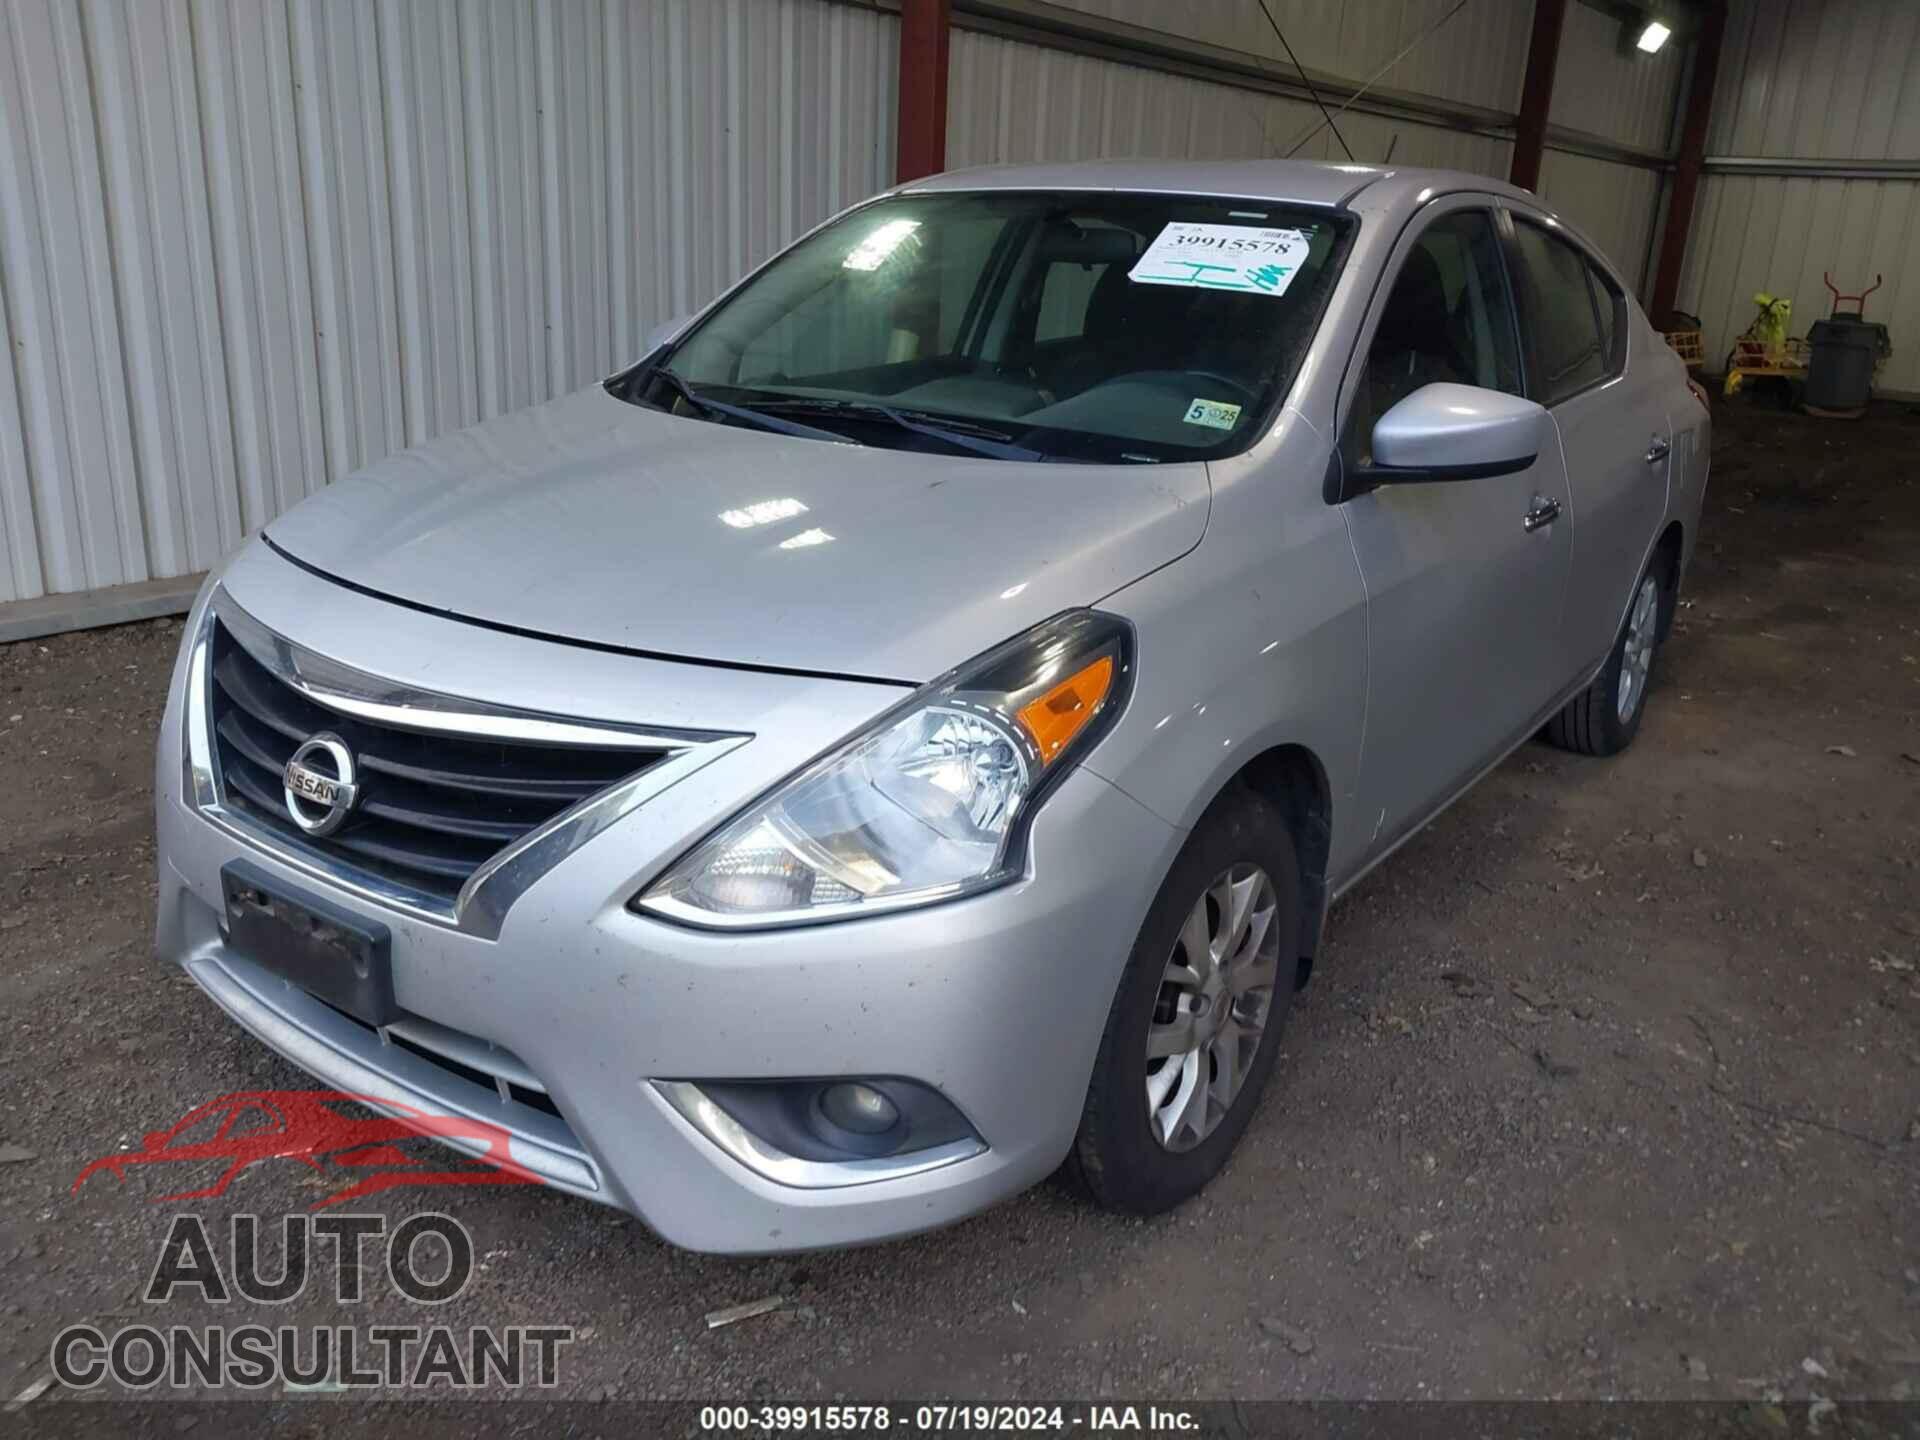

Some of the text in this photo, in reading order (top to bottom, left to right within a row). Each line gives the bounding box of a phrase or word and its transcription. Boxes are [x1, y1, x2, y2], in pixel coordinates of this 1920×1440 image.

[1168, 234, 1292, 255] 39915578
[1190, 405, 1206, 420] 5
[1220, 409, 1237, 422] 25
[287, 766, 341, 801] NISSAN
